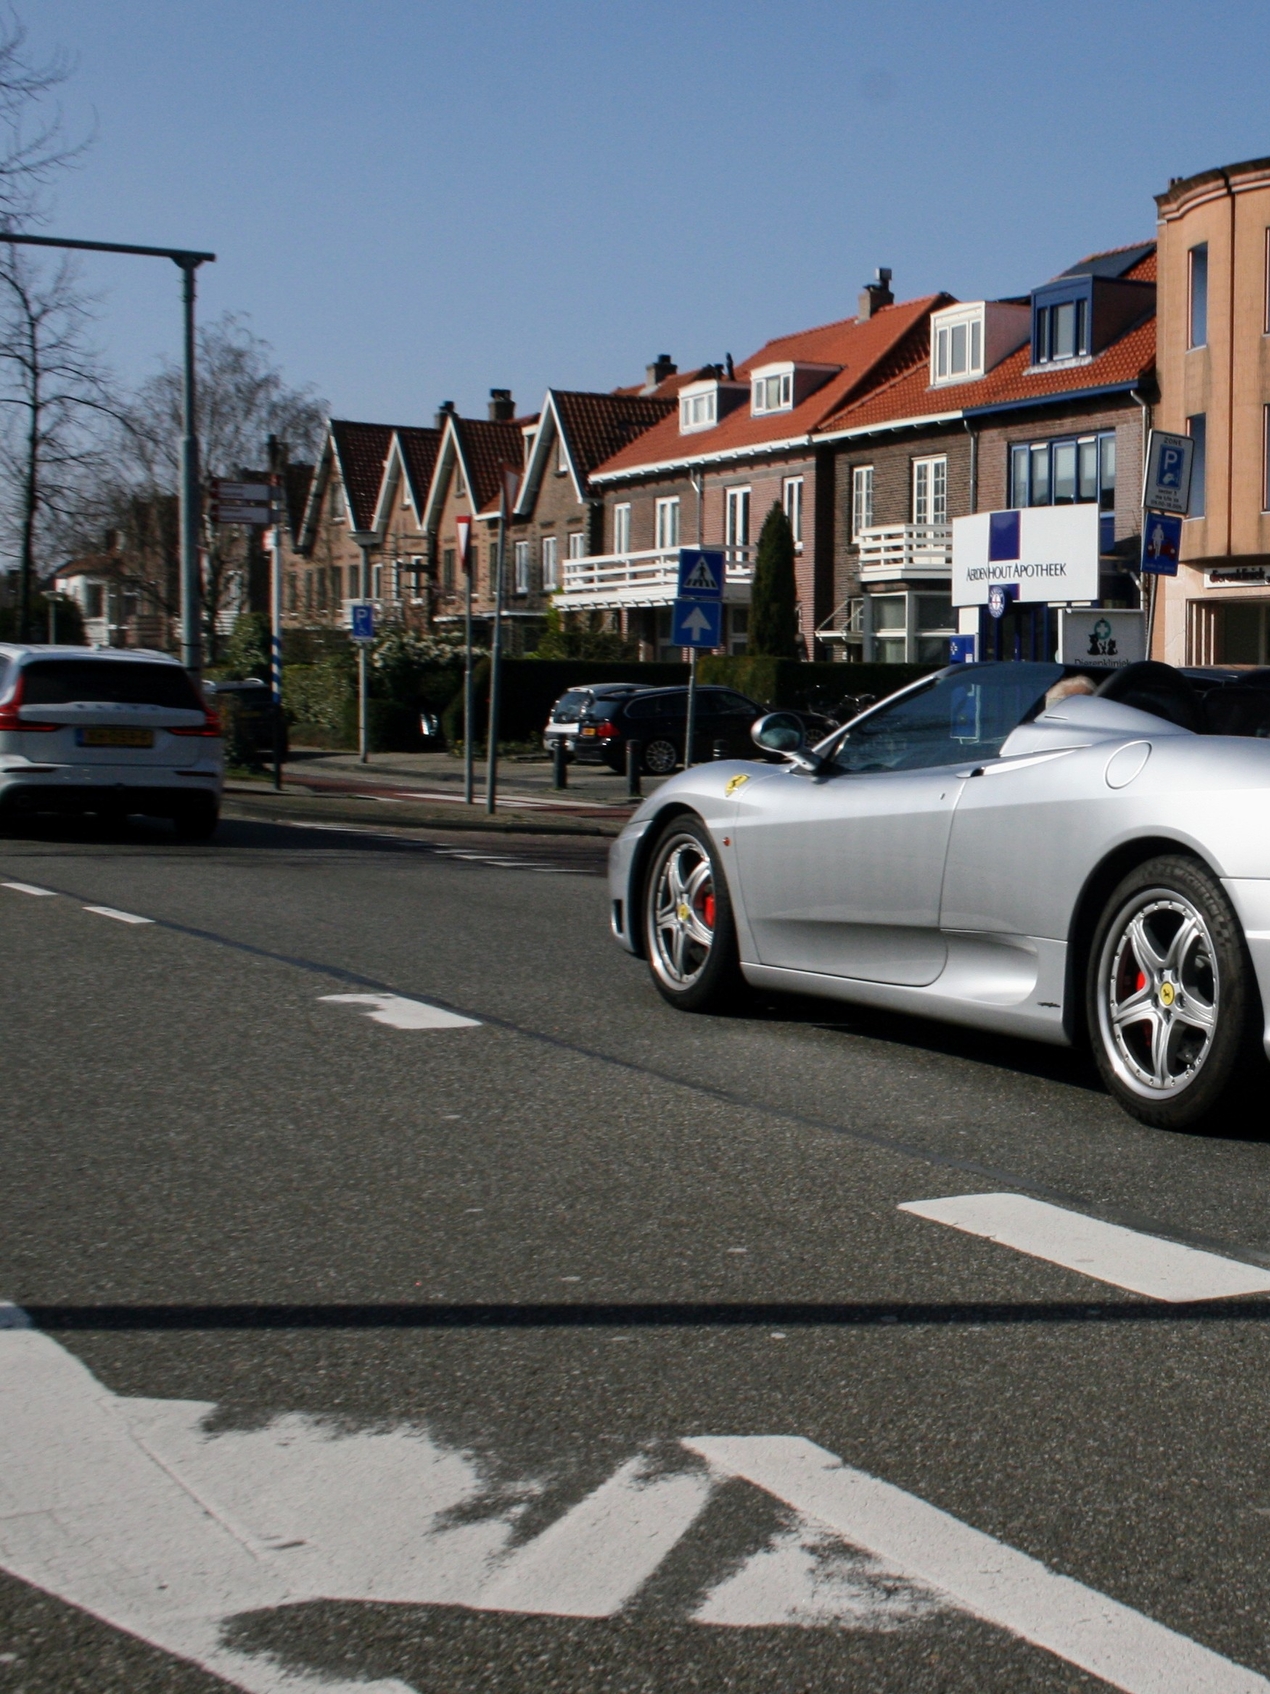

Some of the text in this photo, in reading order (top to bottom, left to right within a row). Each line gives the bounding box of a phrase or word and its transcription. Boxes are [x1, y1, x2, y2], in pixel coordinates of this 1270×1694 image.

[1164, 437, 1182, 447] ZONE
[1164, 450, 1178, 470] P
[966, 562, 1067, 582] AERDENHOUT APOTHEEK
[356, 609, 368, 623] P
[1074, 658, 1131, 668] Dierenkliniek
